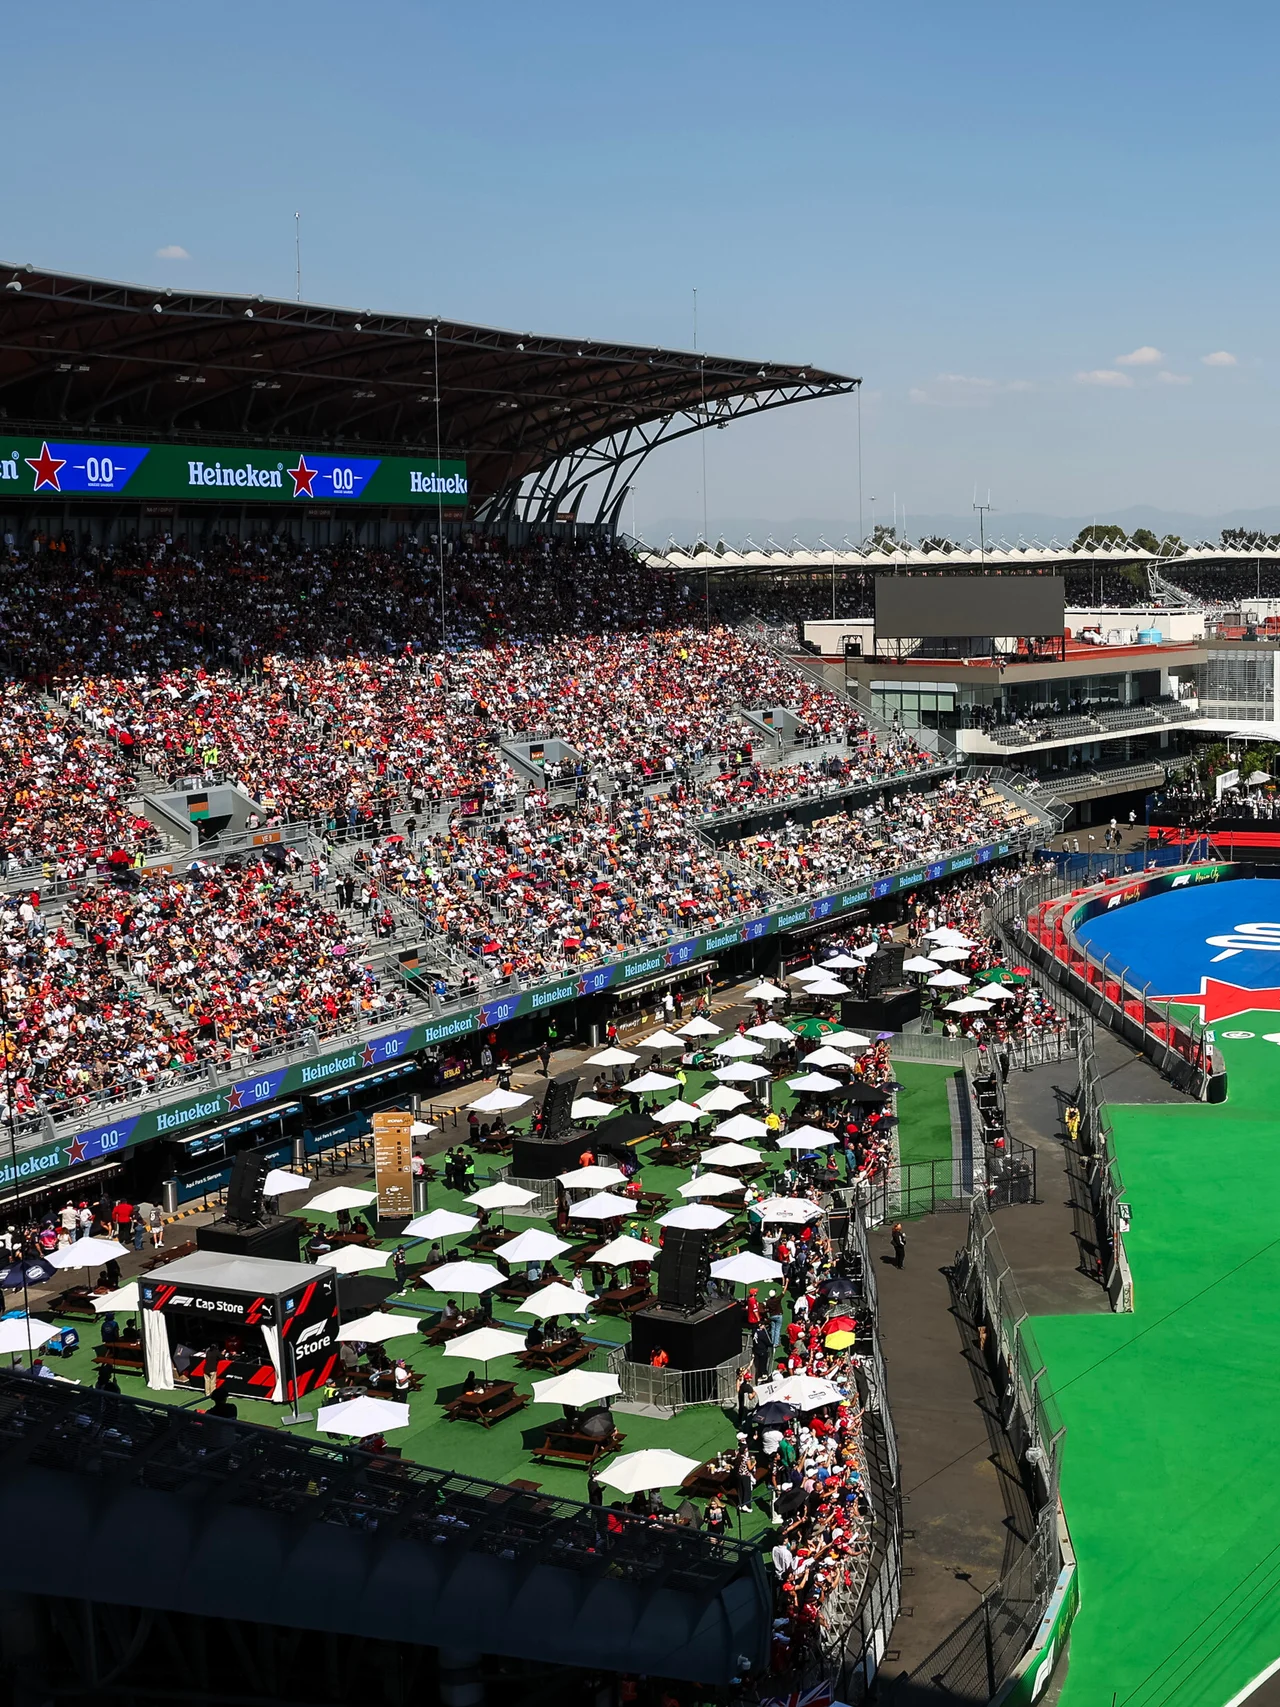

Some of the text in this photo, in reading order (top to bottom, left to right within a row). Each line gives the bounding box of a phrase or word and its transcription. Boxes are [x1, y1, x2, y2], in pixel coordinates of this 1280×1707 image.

[86, 457, 113, 482] 0.0
[188, 461, 282, 488] Heineken
[625, 958, 660, 978] Heineken
[532, 986, 572, 1007] Heineken
[425, 1018, 472, 1043] Heineken
[302, 1056, 356, 1083] Heineken
[156, 1099, 220, 1132] Heineken
[196, 1298, 215, 1311] Cap
[217, 1301, 244, 1314] Store
[296, 1335, 331, 1361] Store
